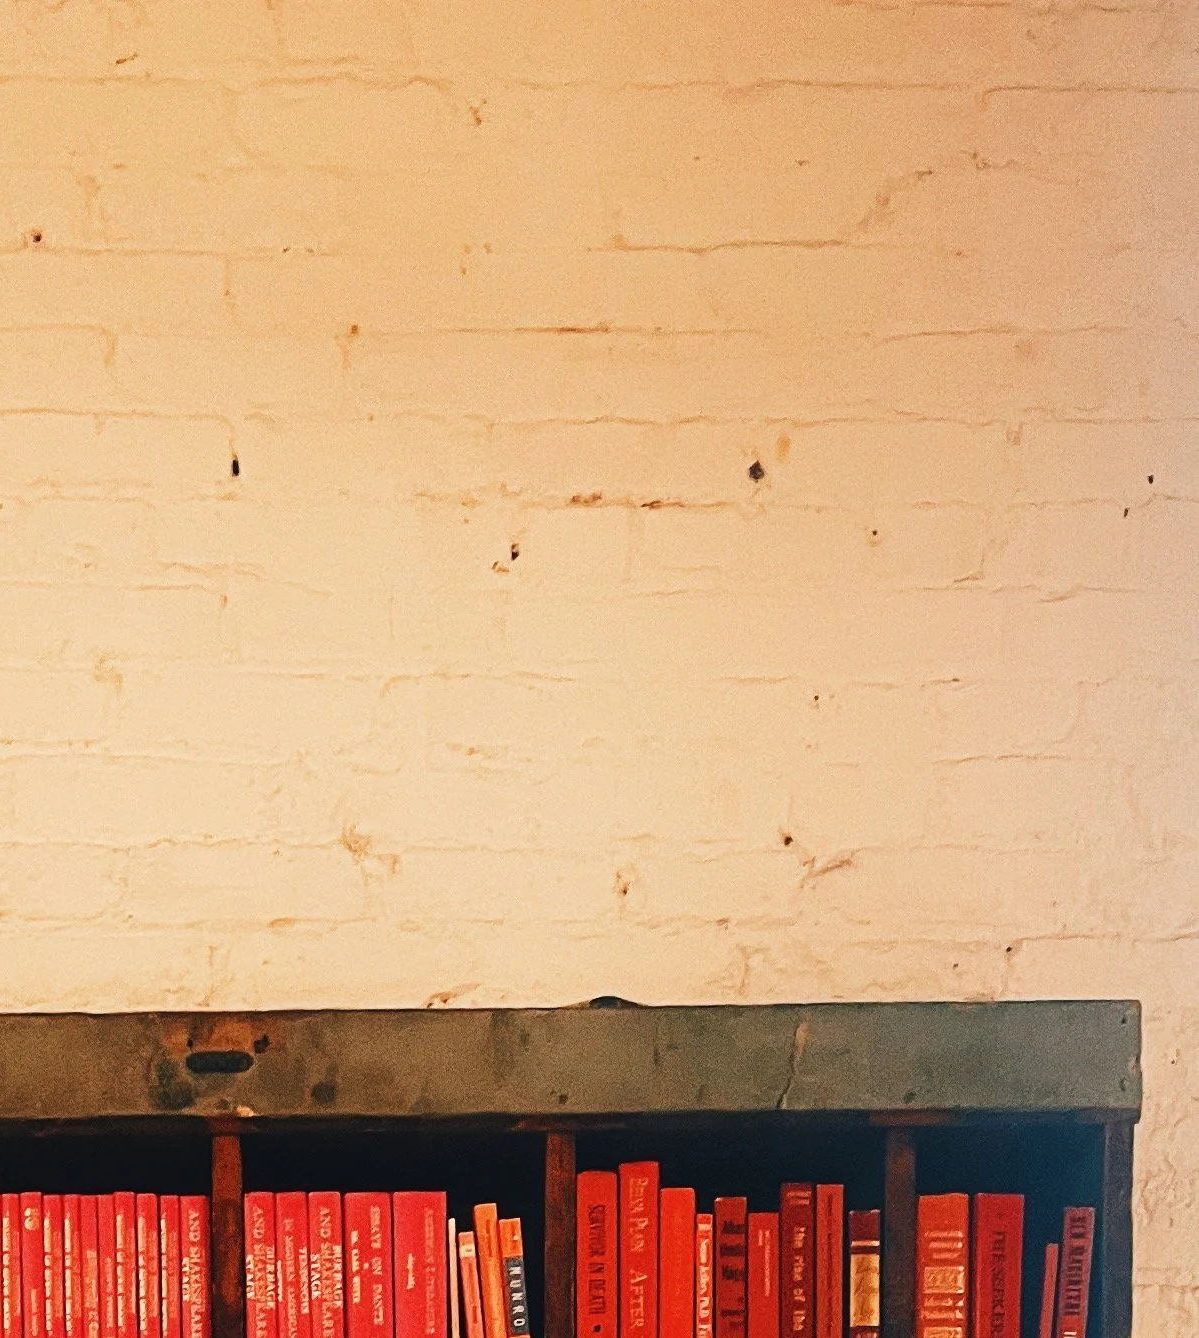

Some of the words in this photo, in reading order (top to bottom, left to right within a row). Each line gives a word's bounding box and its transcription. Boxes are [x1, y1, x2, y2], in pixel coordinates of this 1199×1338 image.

[508, 1266, 526, 1327] MUNRO
[590, 1279, 606, 1315] DEATH
[630, 1268, 648, 1328] AFTER
